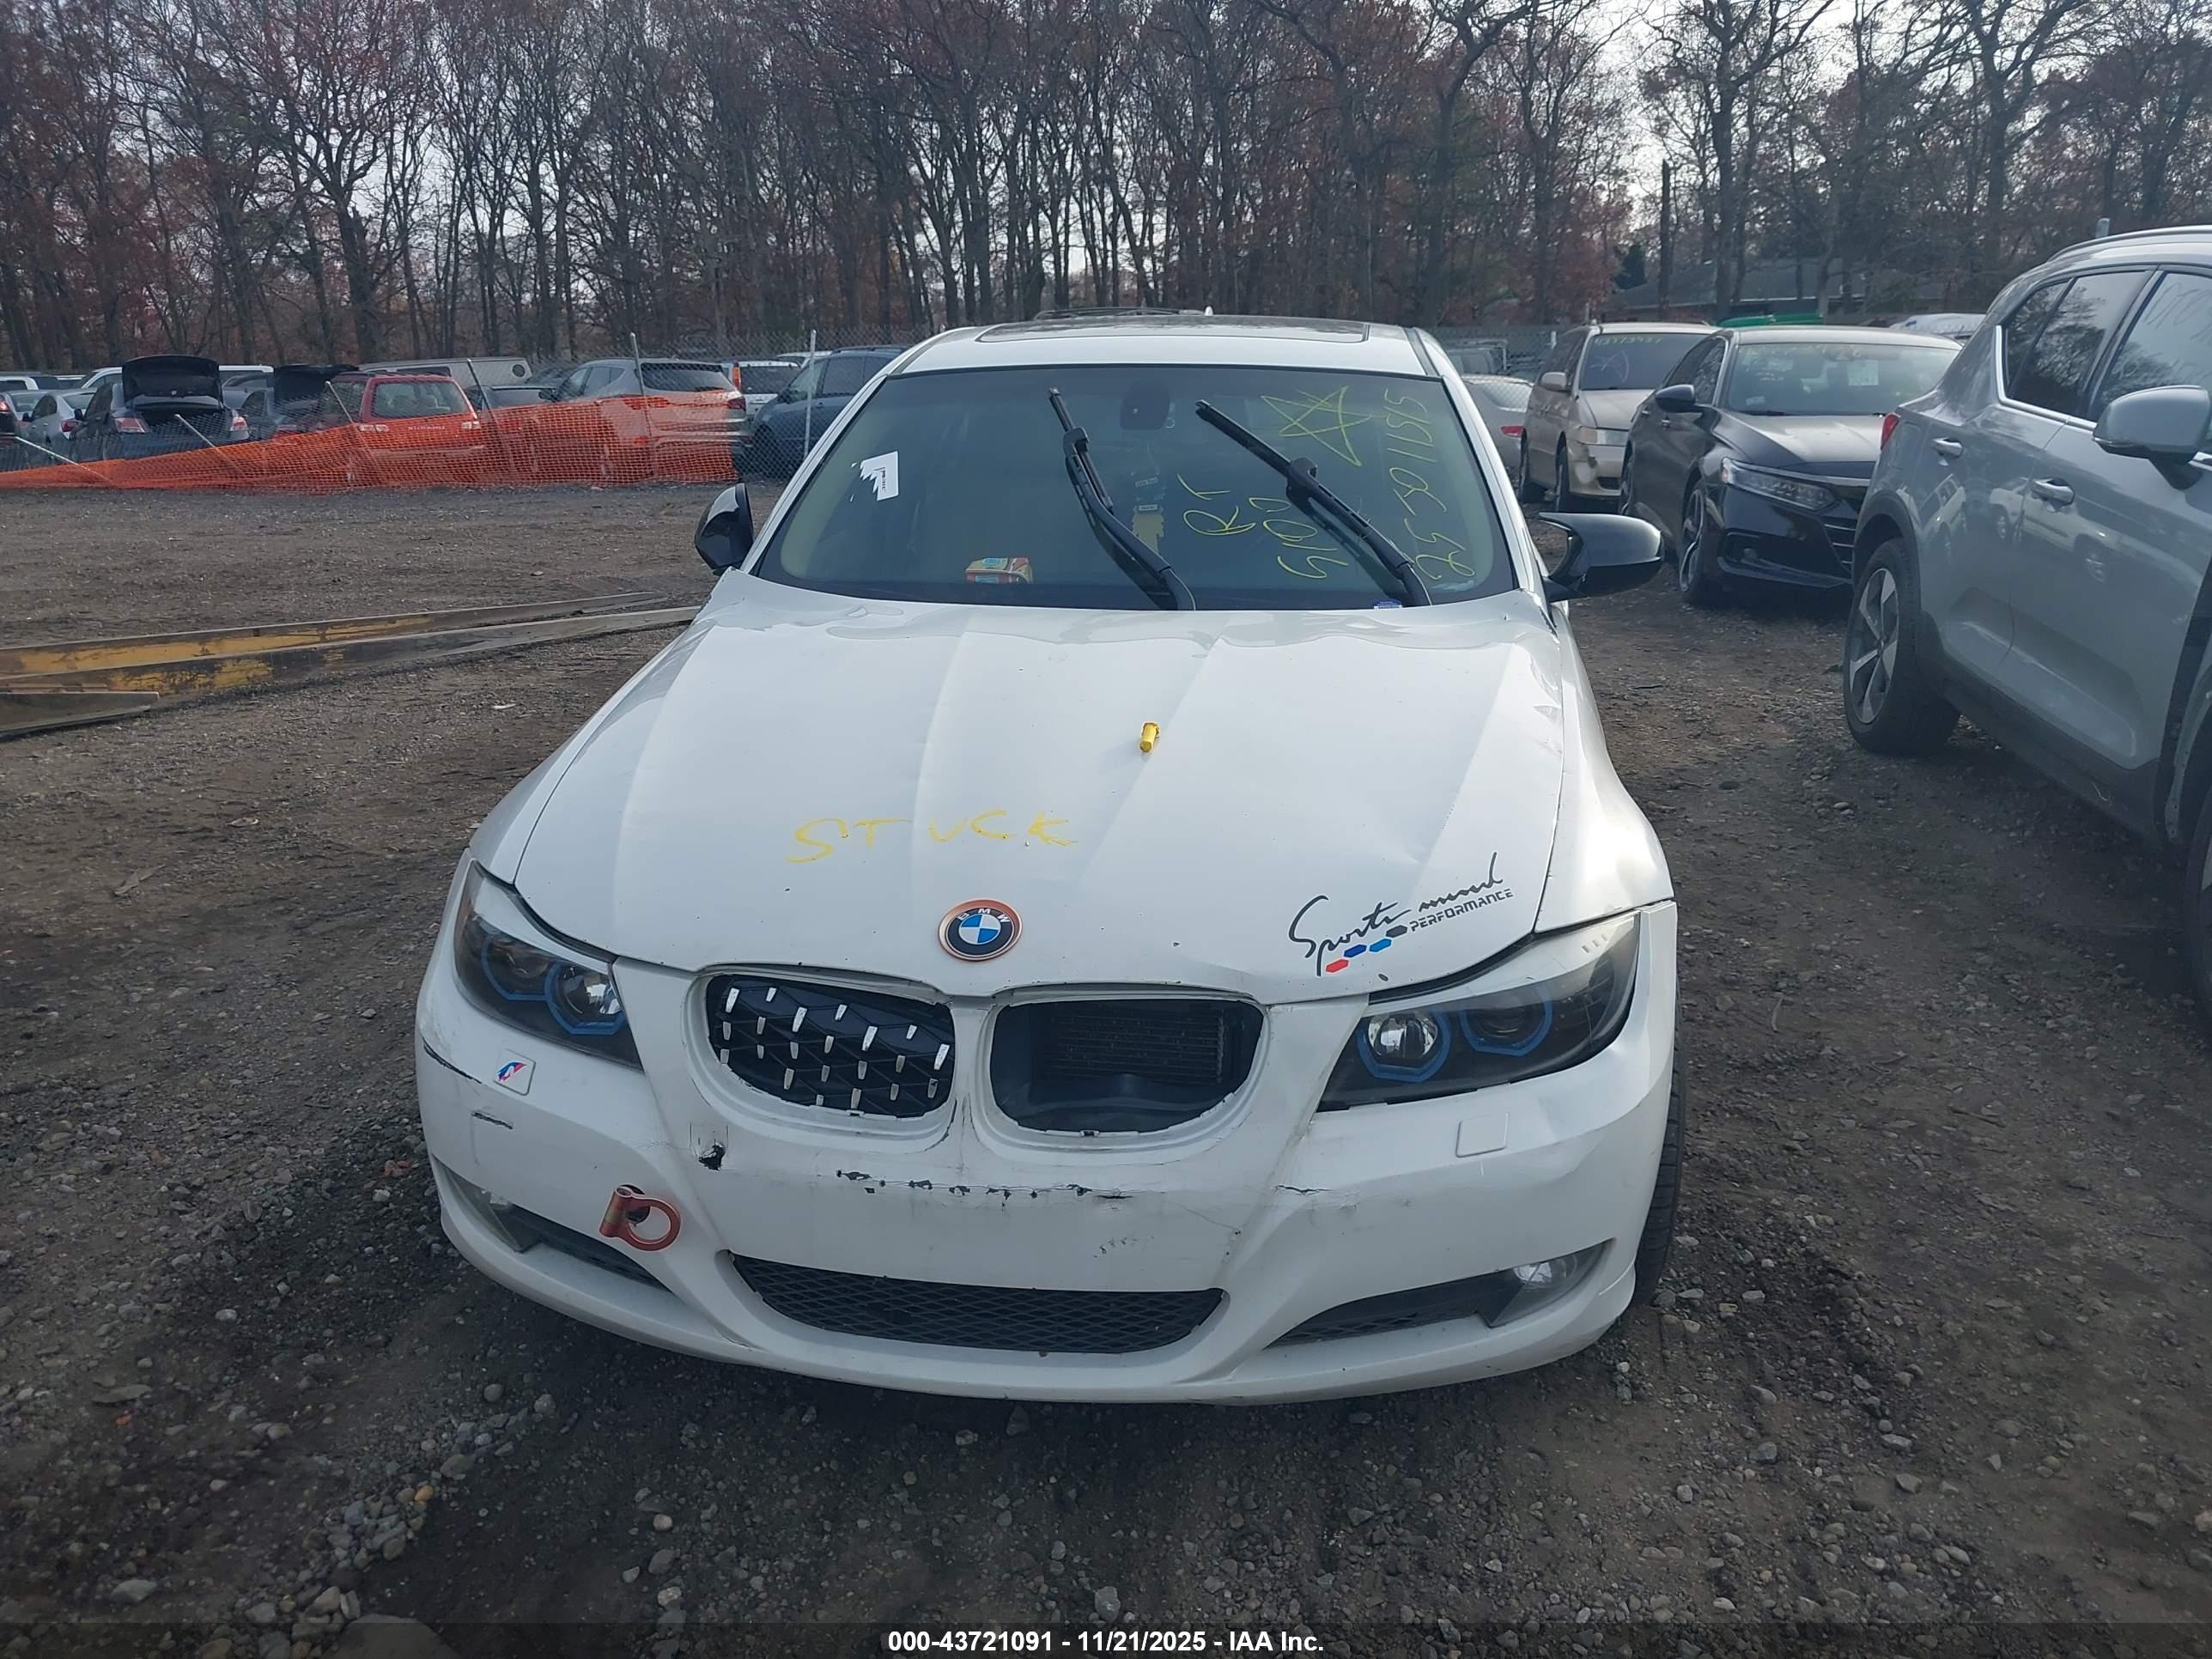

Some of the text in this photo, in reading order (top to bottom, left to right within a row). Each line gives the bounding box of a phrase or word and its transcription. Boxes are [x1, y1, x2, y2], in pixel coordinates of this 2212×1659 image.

[785, 810, 1079, 863] STUCK
[957, 908, 1011, 923] BMW
[1409, 888, 1514, 933] PERFORMANCE
